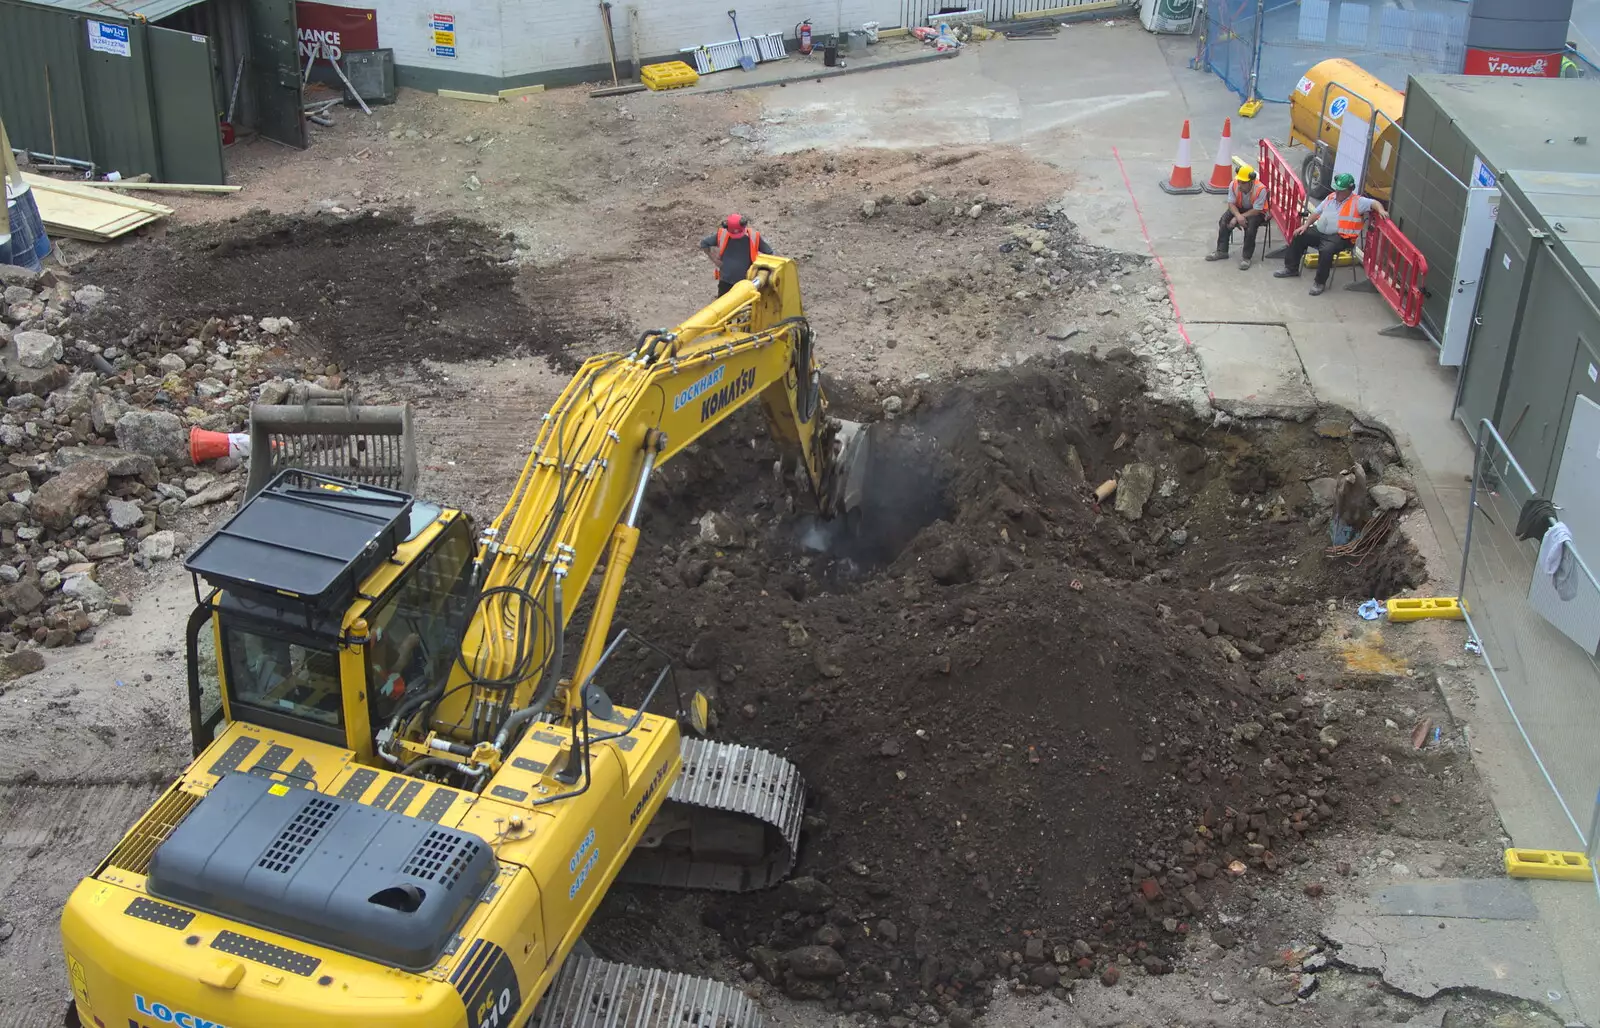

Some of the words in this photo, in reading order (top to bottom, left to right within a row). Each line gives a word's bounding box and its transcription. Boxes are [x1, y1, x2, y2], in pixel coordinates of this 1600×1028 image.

[1488, 61, 1538, 75] V-Powe
[674, 364, 726, 413] LOCKHART
[700, 366, 757, 423] KOMATSU
[629, 760, 669, 825] KOMATSU
[477, 989, 495, 1025] PC
